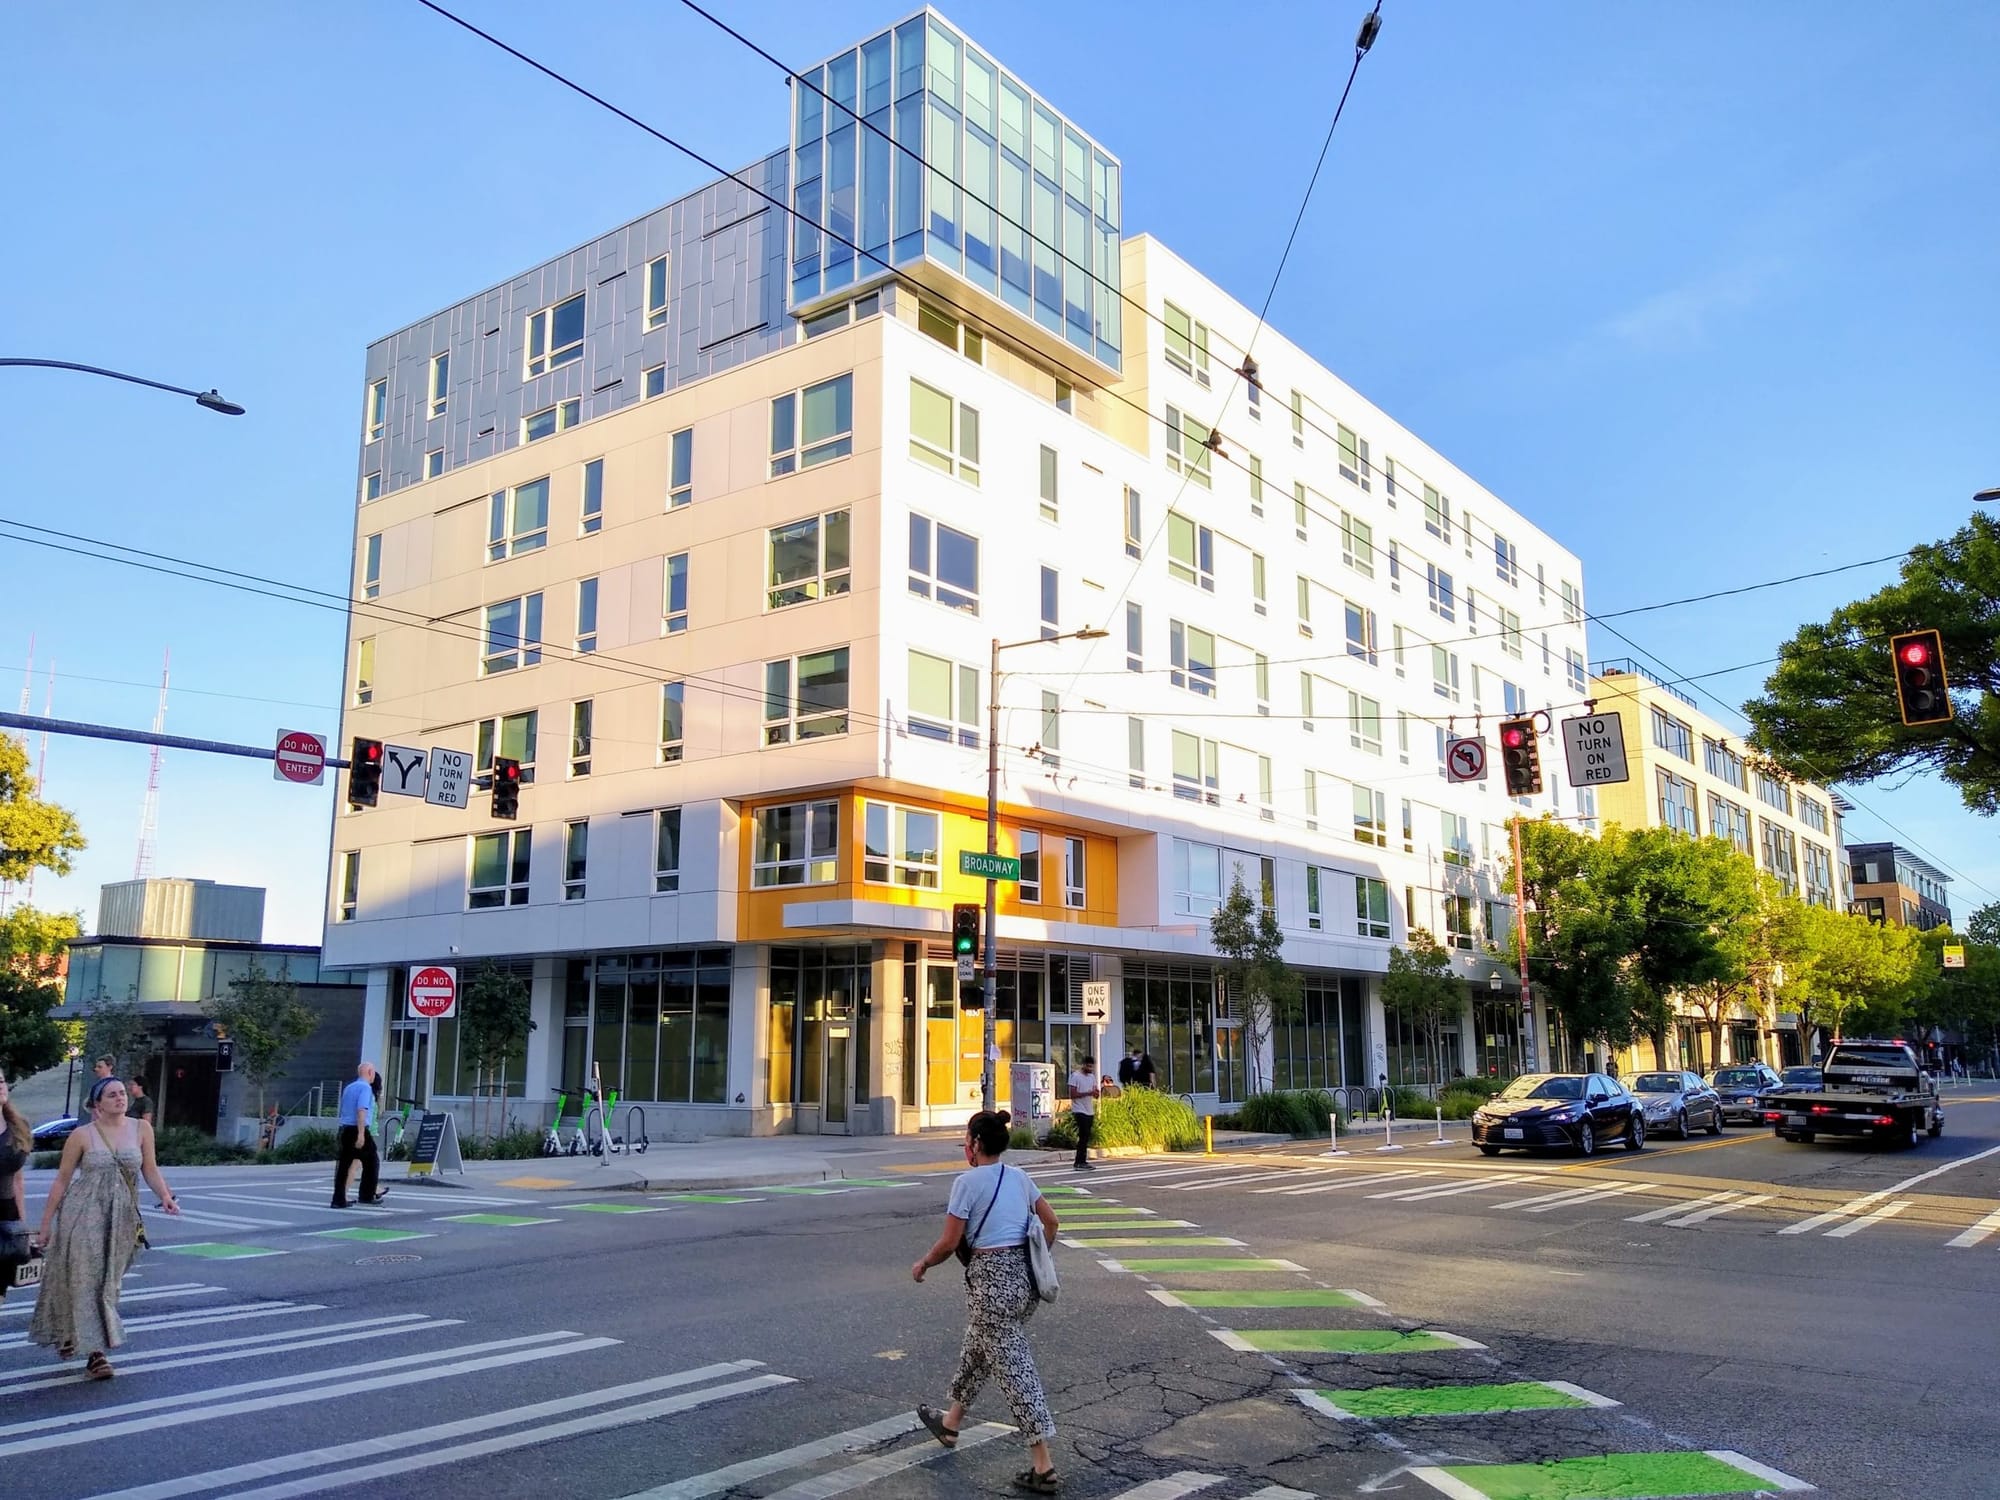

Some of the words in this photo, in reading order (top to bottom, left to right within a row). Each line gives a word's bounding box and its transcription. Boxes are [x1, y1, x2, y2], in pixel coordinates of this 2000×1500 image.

[1579, 720, 1605, 736] NO
[284, 740, 297, 750] DO
[301, 743, 319, 754] NOT
[1576, 736, 1612, 751] TURN
[443, 753, 462, 768] NO
[1587, 752, 1605, 765] ON
[285, 763, 314, 775] ENTER
[439, 767, 463, 780] TURN
[1585, 767, 1612, 780] RED
[443, 781, 456, 791] ON
[438, 792, 457, 804] RED
[964, 855, 1014, 875] BROADWAY
[417, 976, 429, 985] DO
[433, 977, 449, 985] NOT
[1087, 986, 1105, 996] ONE
[1087, 997, 1105, 1006] WAY
